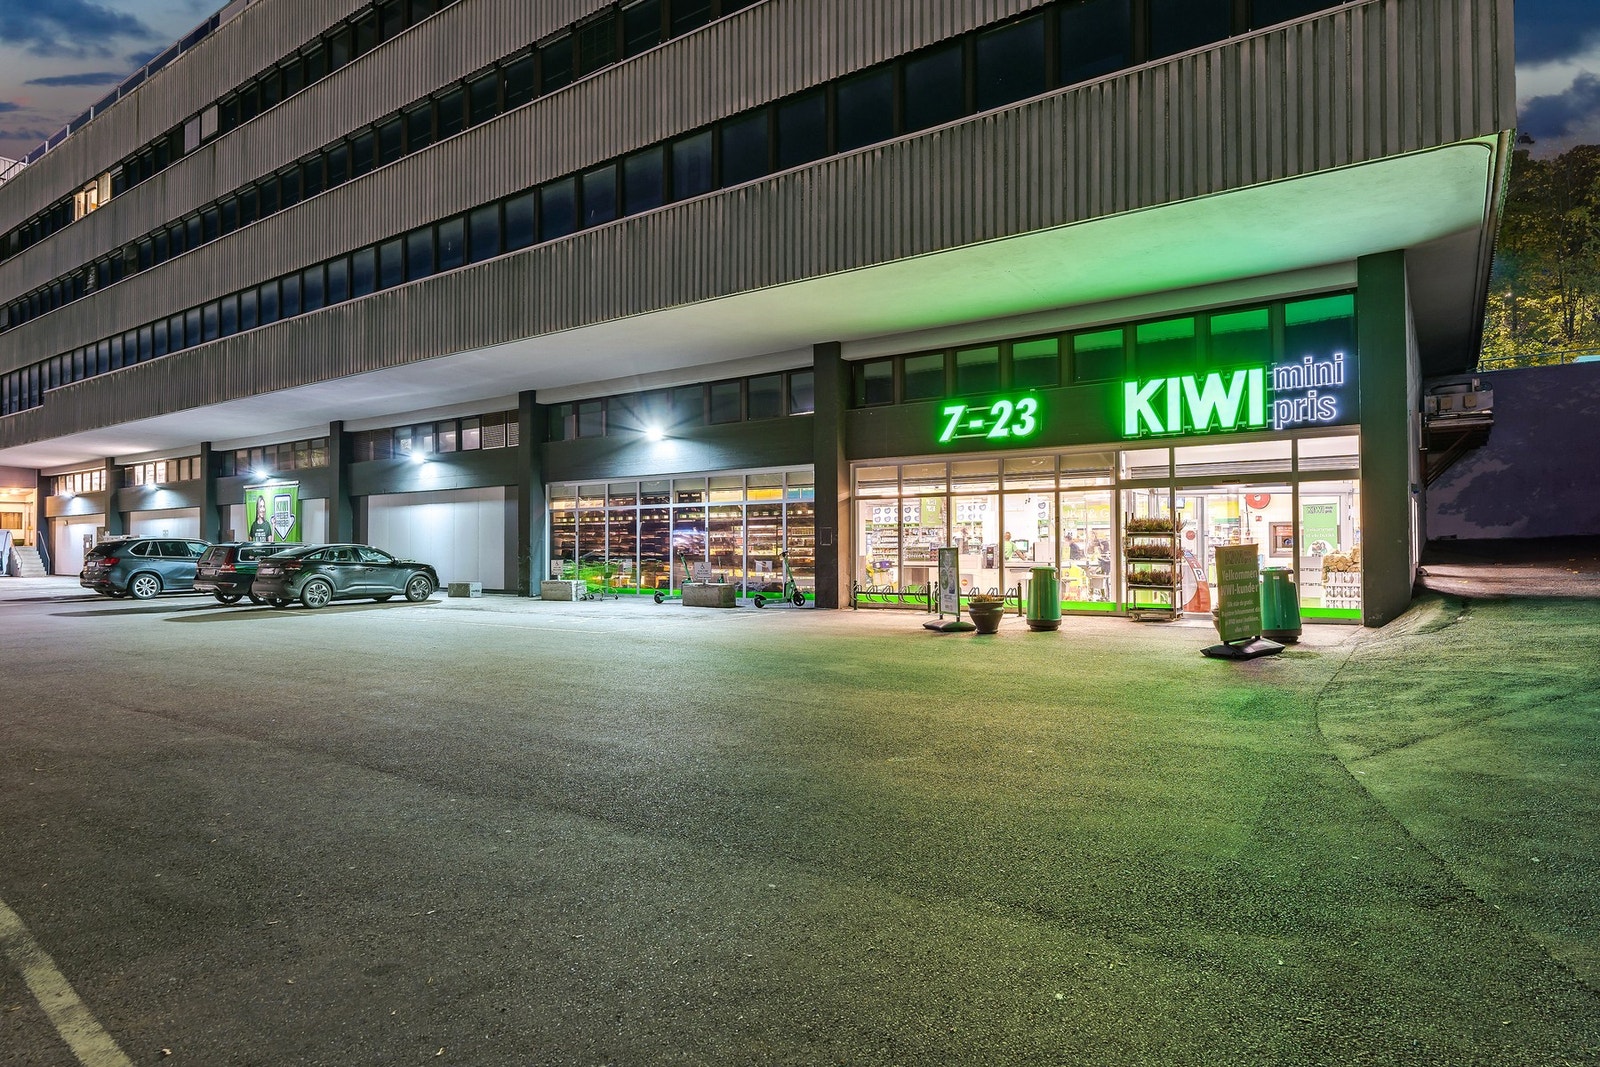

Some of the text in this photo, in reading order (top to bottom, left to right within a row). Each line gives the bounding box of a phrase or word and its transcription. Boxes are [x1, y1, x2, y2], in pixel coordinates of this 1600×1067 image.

[1274, 353, 1344, 391] mini
[939, 397, 1038, 442] 7-23
[1123, 367, 1266, 438] KIWI
[1273, 390, 1337, 430] pris
[1222, 569, 1258, 581] Velkommen
